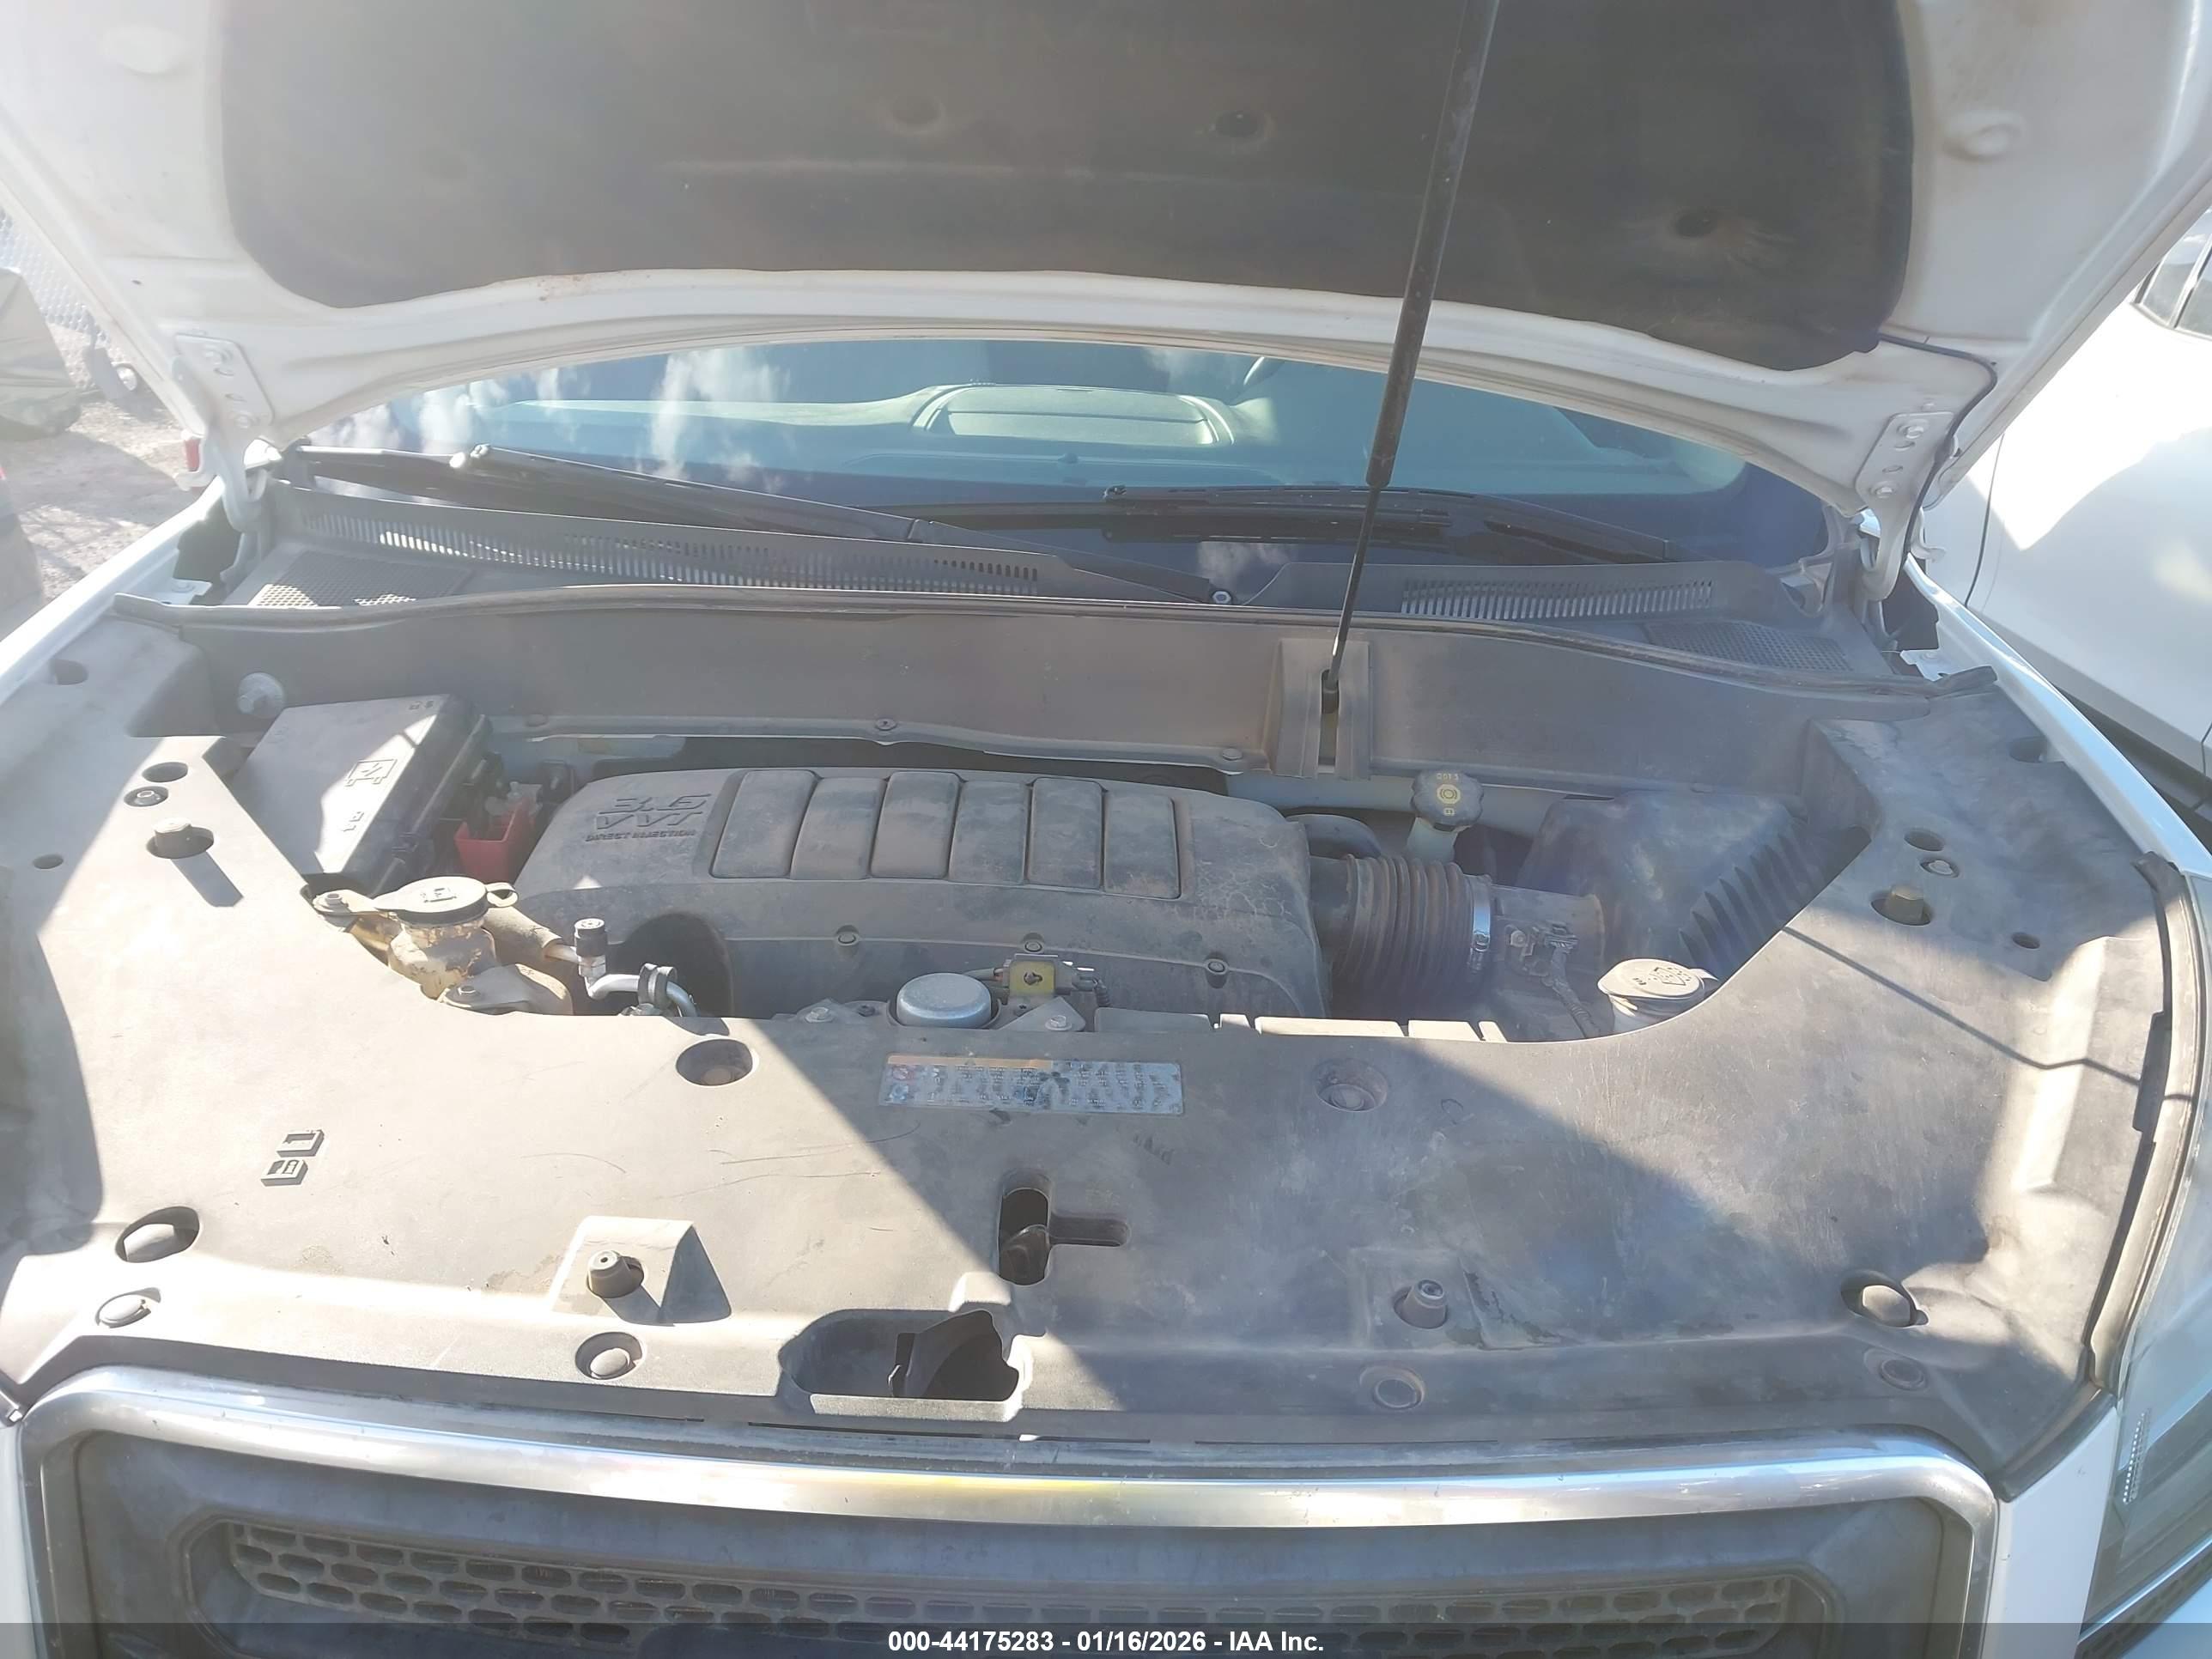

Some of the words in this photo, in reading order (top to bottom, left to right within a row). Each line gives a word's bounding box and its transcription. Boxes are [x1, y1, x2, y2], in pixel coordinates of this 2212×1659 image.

[599, 793, 712, 814] 3.6
[596, 811, 704, 830] VVT
[585, 831, 631, 842] DIRECT
[631, 830, 696, 840] INJECTION
